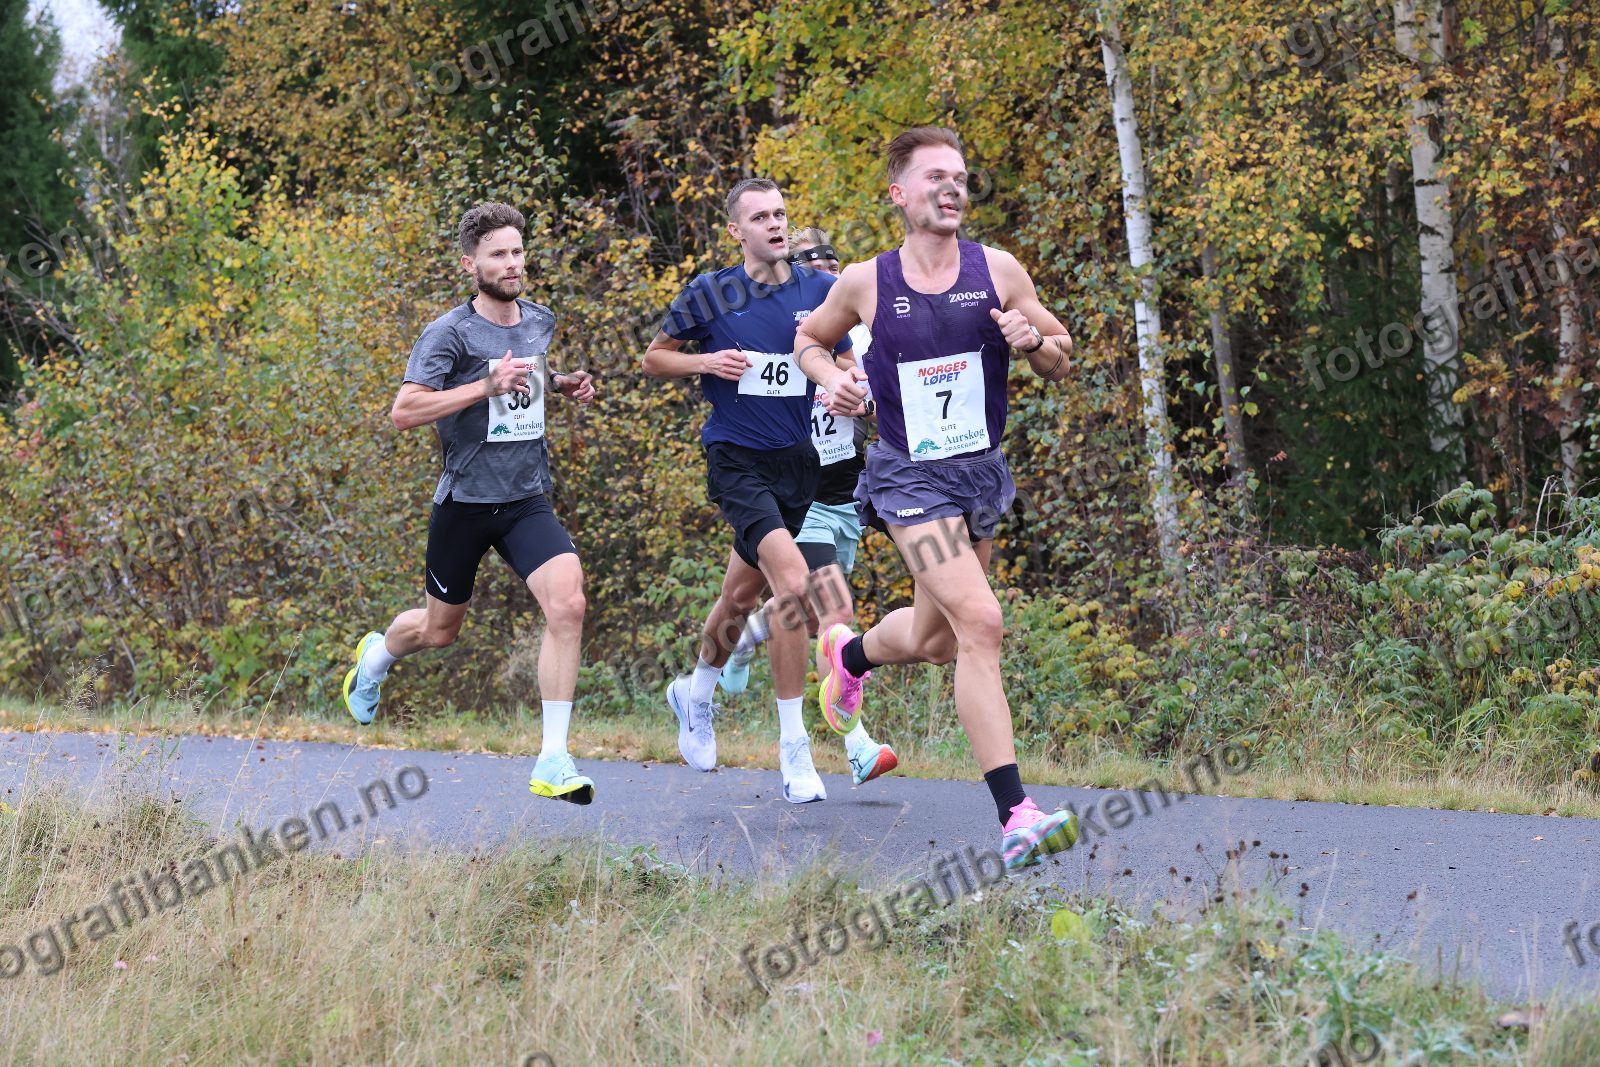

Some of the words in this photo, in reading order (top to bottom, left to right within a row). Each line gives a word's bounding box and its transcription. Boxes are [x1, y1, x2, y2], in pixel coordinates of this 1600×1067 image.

[760, 362, 789, 386] 46
[918, 361, 967, 377] NORGES
[923, 371, 961, 386] LØPET
[936, 390, 952, 419] 7
[944, 428, 986, 445] Aurskog
[896, 507, 924, 518] HOKA
